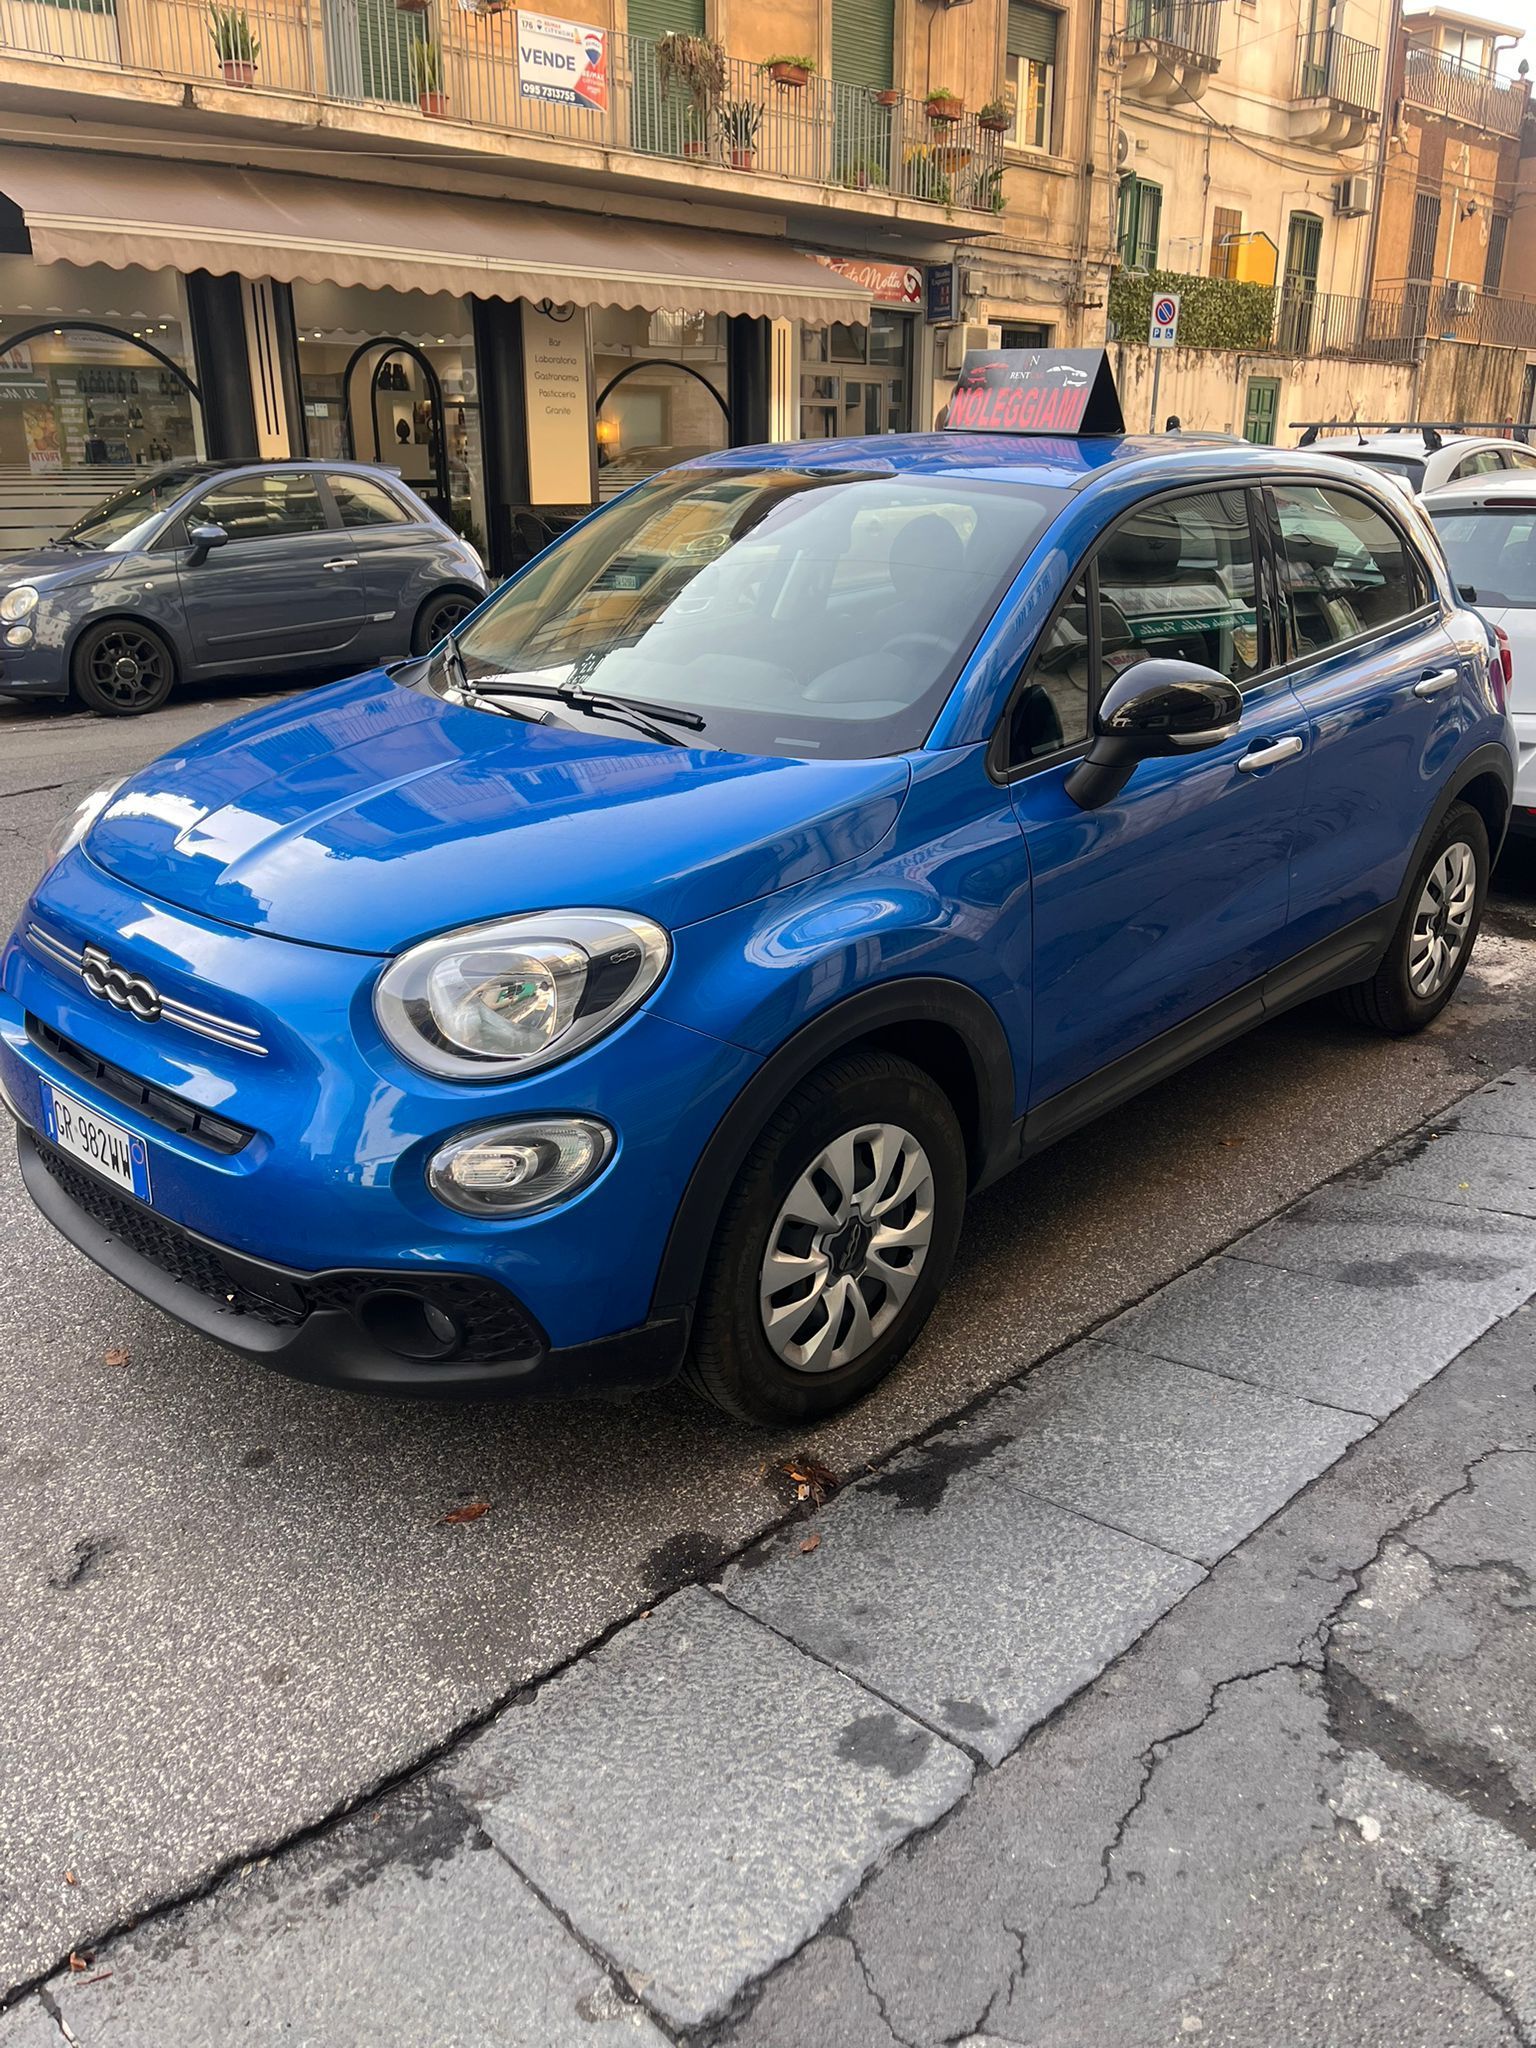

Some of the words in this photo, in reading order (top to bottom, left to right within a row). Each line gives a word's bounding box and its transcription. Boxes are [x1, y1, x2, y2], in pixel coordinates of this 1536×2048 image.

[521, 19, 534, 30] 176
[521, 46, 576, 72] VENDE
[523, 83, 540, 94] 095
[542, 86, 576, 102] 7313755
[859, 266, 902, 290] Motta
[548, 338, 561, 347] Bar
[534, 354, 577, 365] Laboratorio
[534, 371, 579, 382] Gastronomia
[1010, 371, 1031, 380] RENT
[539, 388, 576, 399] Pasticceria
[948, 387, 1088, 431] NOLEGGIAMI
[610, 949, 637, 964] 500
[83, 947, 160, 1016] 500
[54, 1100, 75, 1144] GR
[78, 1116, 132, 1180] 982WW
